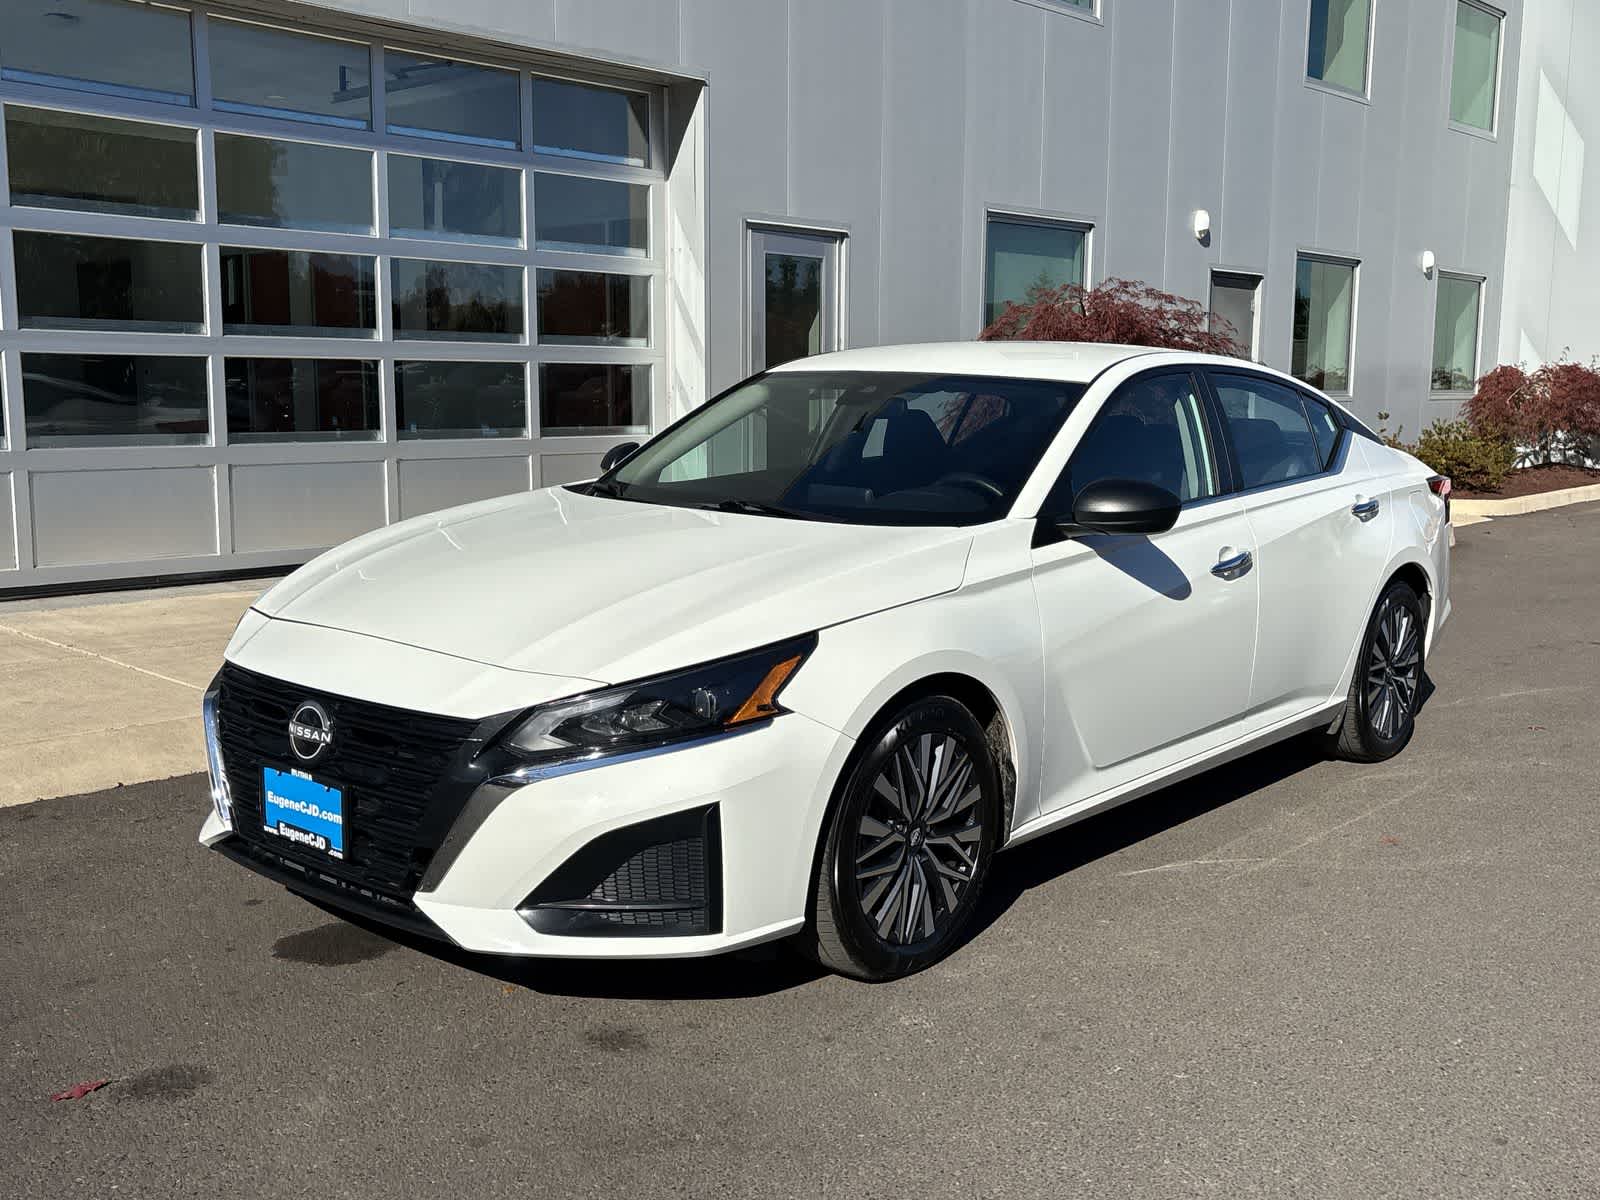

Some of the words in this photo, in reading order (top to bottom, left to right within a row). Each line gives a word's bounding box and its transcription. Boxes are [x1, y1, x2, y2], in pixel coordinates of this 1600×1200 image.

[289, 722, 331, 743] NISSAN
[267, 790, 343, 824] EugeneCJD.com
[279, 822, 326, 850] EugeneCJD
